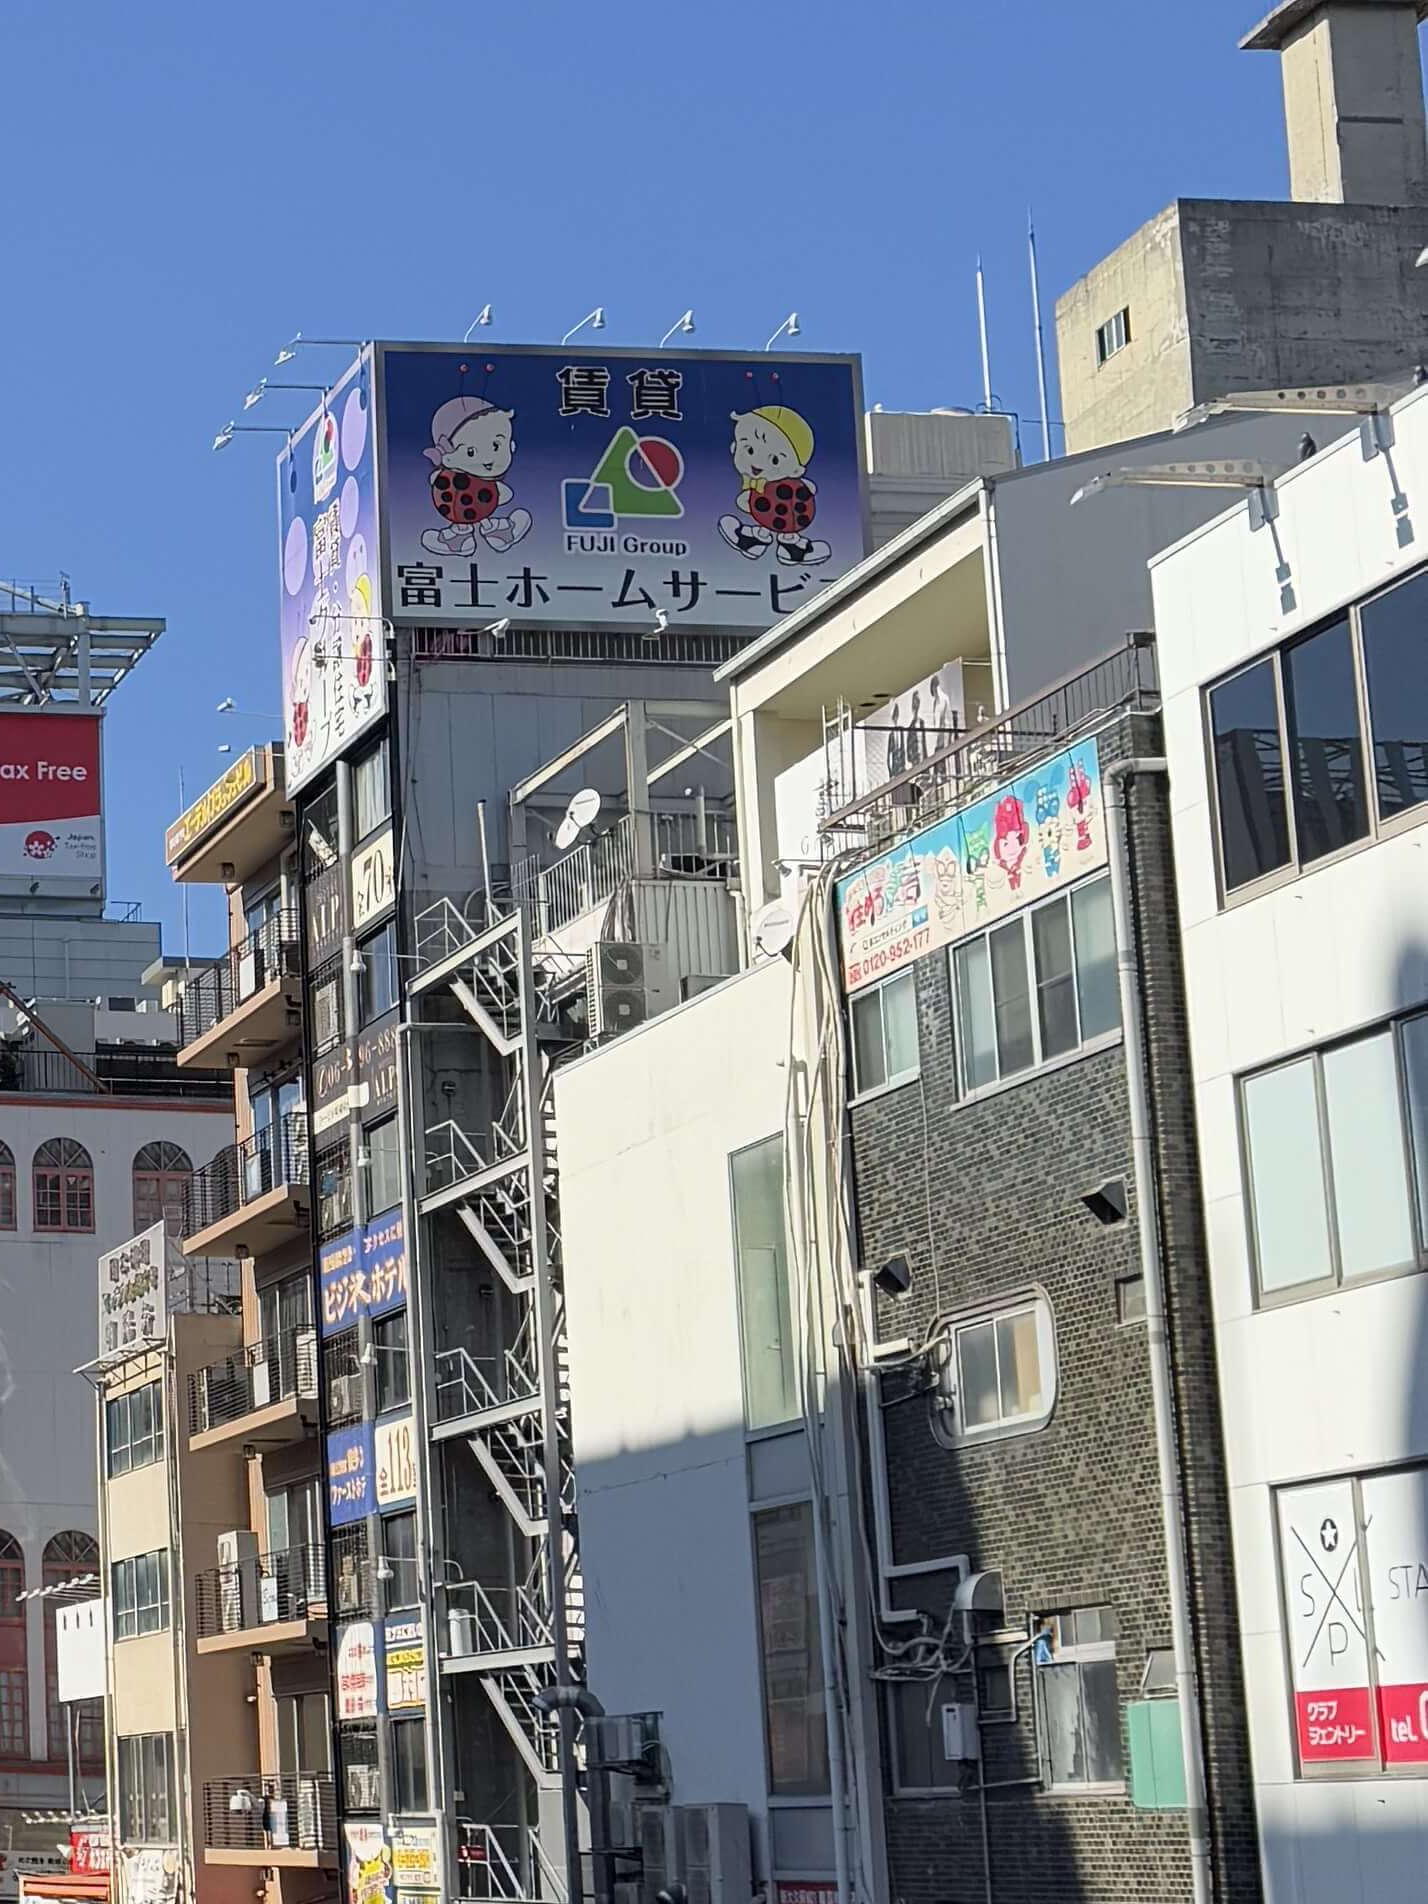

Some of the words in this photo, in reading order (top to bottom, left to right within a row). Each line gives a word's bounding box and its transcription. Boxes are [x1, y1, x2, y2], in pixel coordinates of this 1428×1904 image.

[556, 365, 684, 420] 賃貸
[566, 534, 615, 555] FUJI
[623, 536, 688, 558] Group
[37, 760, 88, 782] Free
